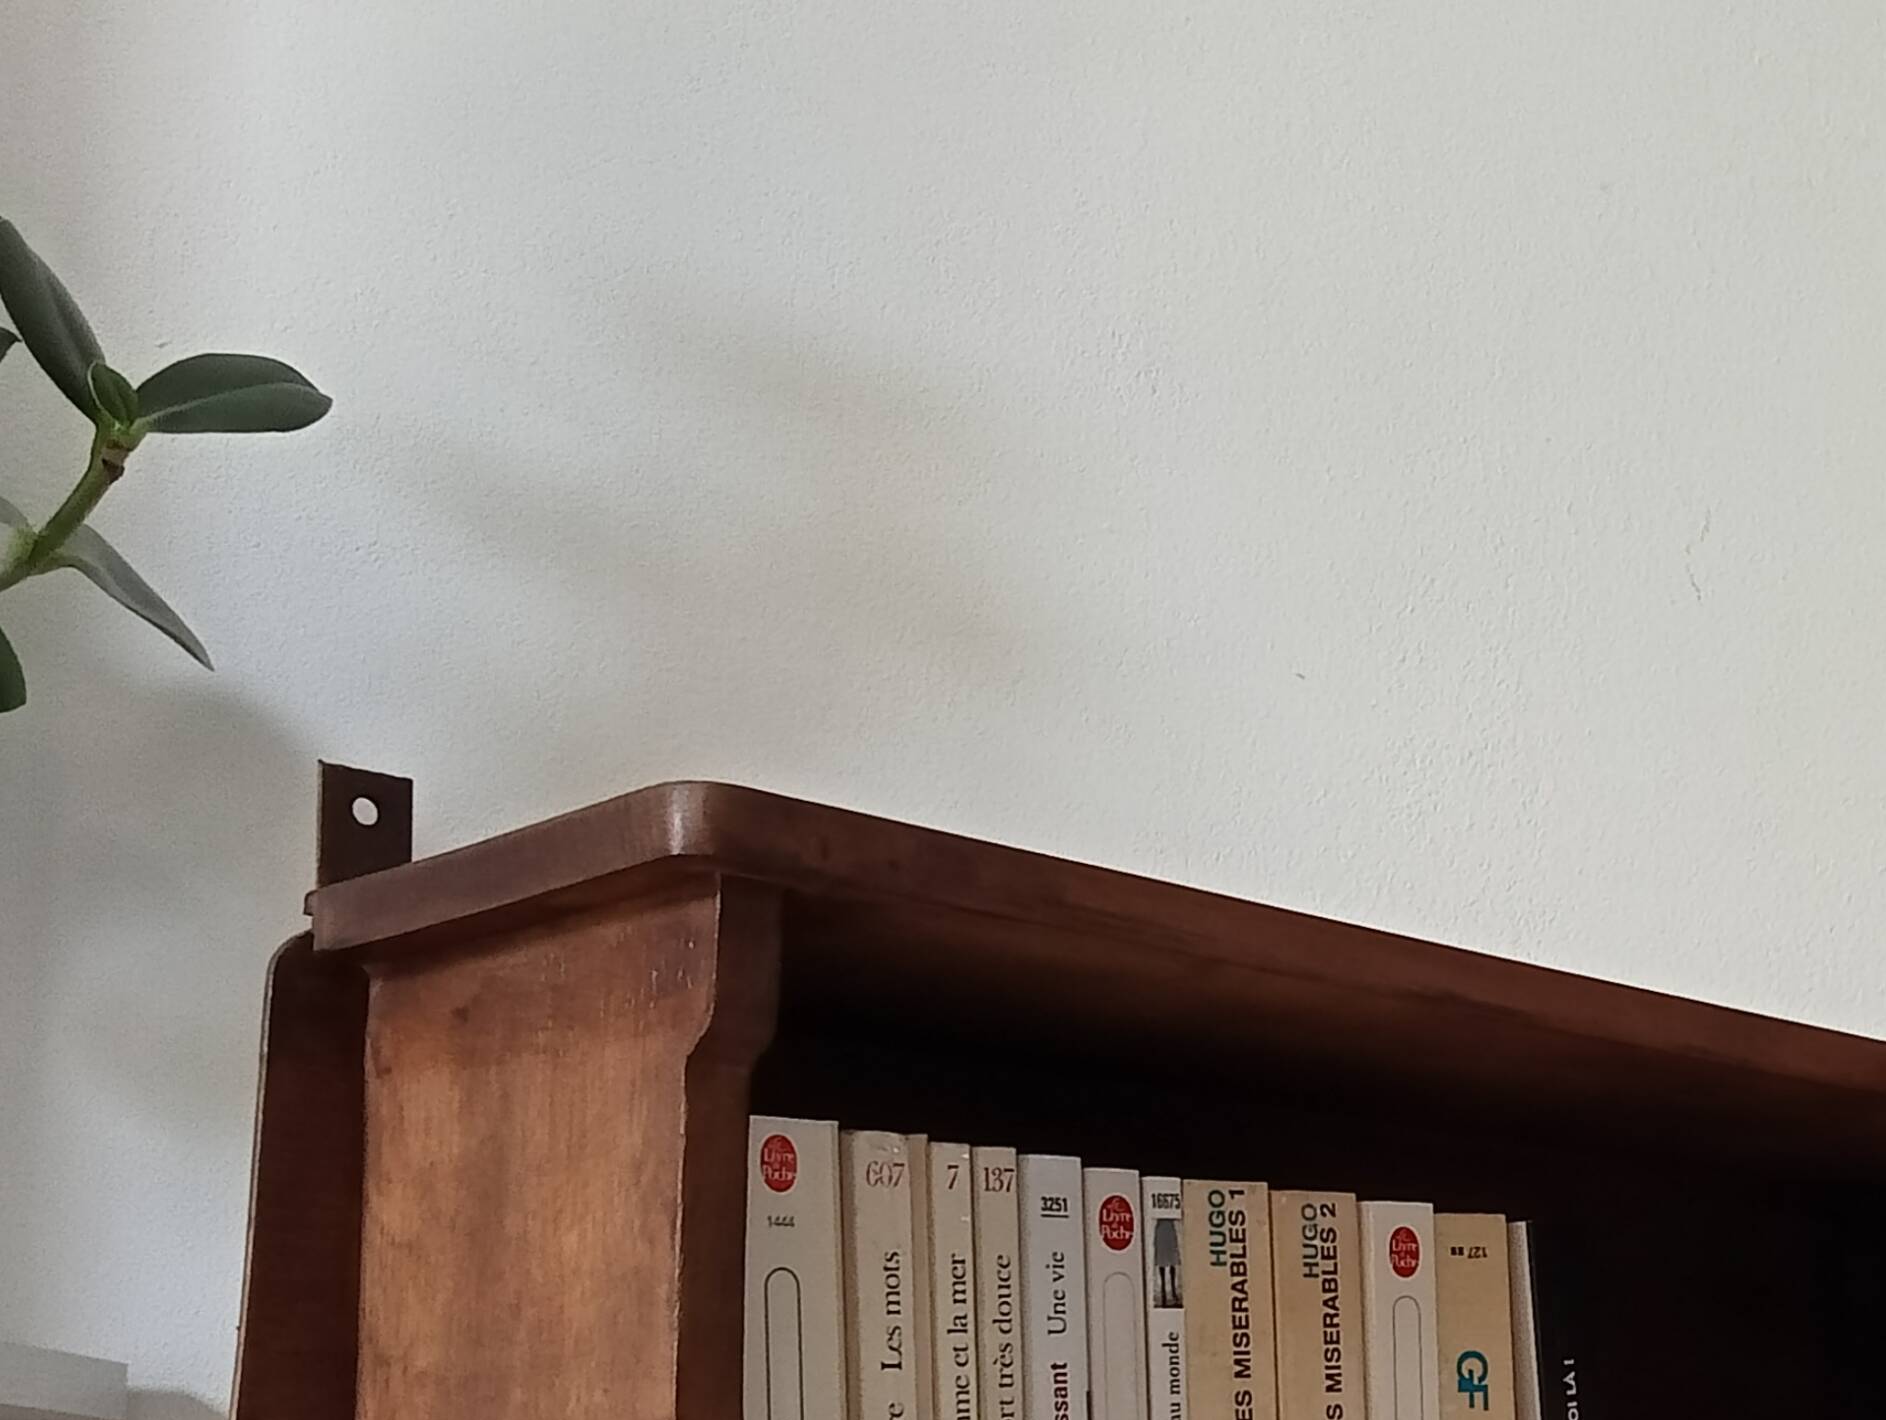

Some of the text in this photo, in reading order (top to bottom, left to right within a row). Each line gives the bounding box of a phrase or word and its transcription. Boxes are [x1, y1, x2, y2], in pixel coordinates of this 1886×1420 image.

[866, 1160, 905, 1188] 607
[947, 1165, 959, 1189] 7
[983, 1167, 1015, 1193] 137
[1228, 1189, 1244, 1198] 1
[1041, 1197, 1068, 1212] 3251
[1319, 1203, 1336, 1218] 2
[1208, 1190, 1227, 1267] HUGO
[1301, 1203, 1318, 1279] HUGO
[883, 1251, 901, 1315] mots
[950, 1253, 966, 1304] mer
[1045, 1251, 1065, 1282] vie
[993, 1254, 1013, 1335] douce
[1047, 1290, 1066, 1335] Une
[1229, 1210, 1251, 1379] MISERABLES
[1320, 1227, 1342, 1393] MISERABLES
[947, 1314, 968, 1334] la
[881, 1326, 902, 1370] Les
[952, 1344, 968, 1367] et
[994, 1343, 1014, 1388] très
[1162, 1331, 1180, 1395] monde
[1456, 1350, 1489, 1411] GF
[1563, 1371, 1577, 1395] LÀ
